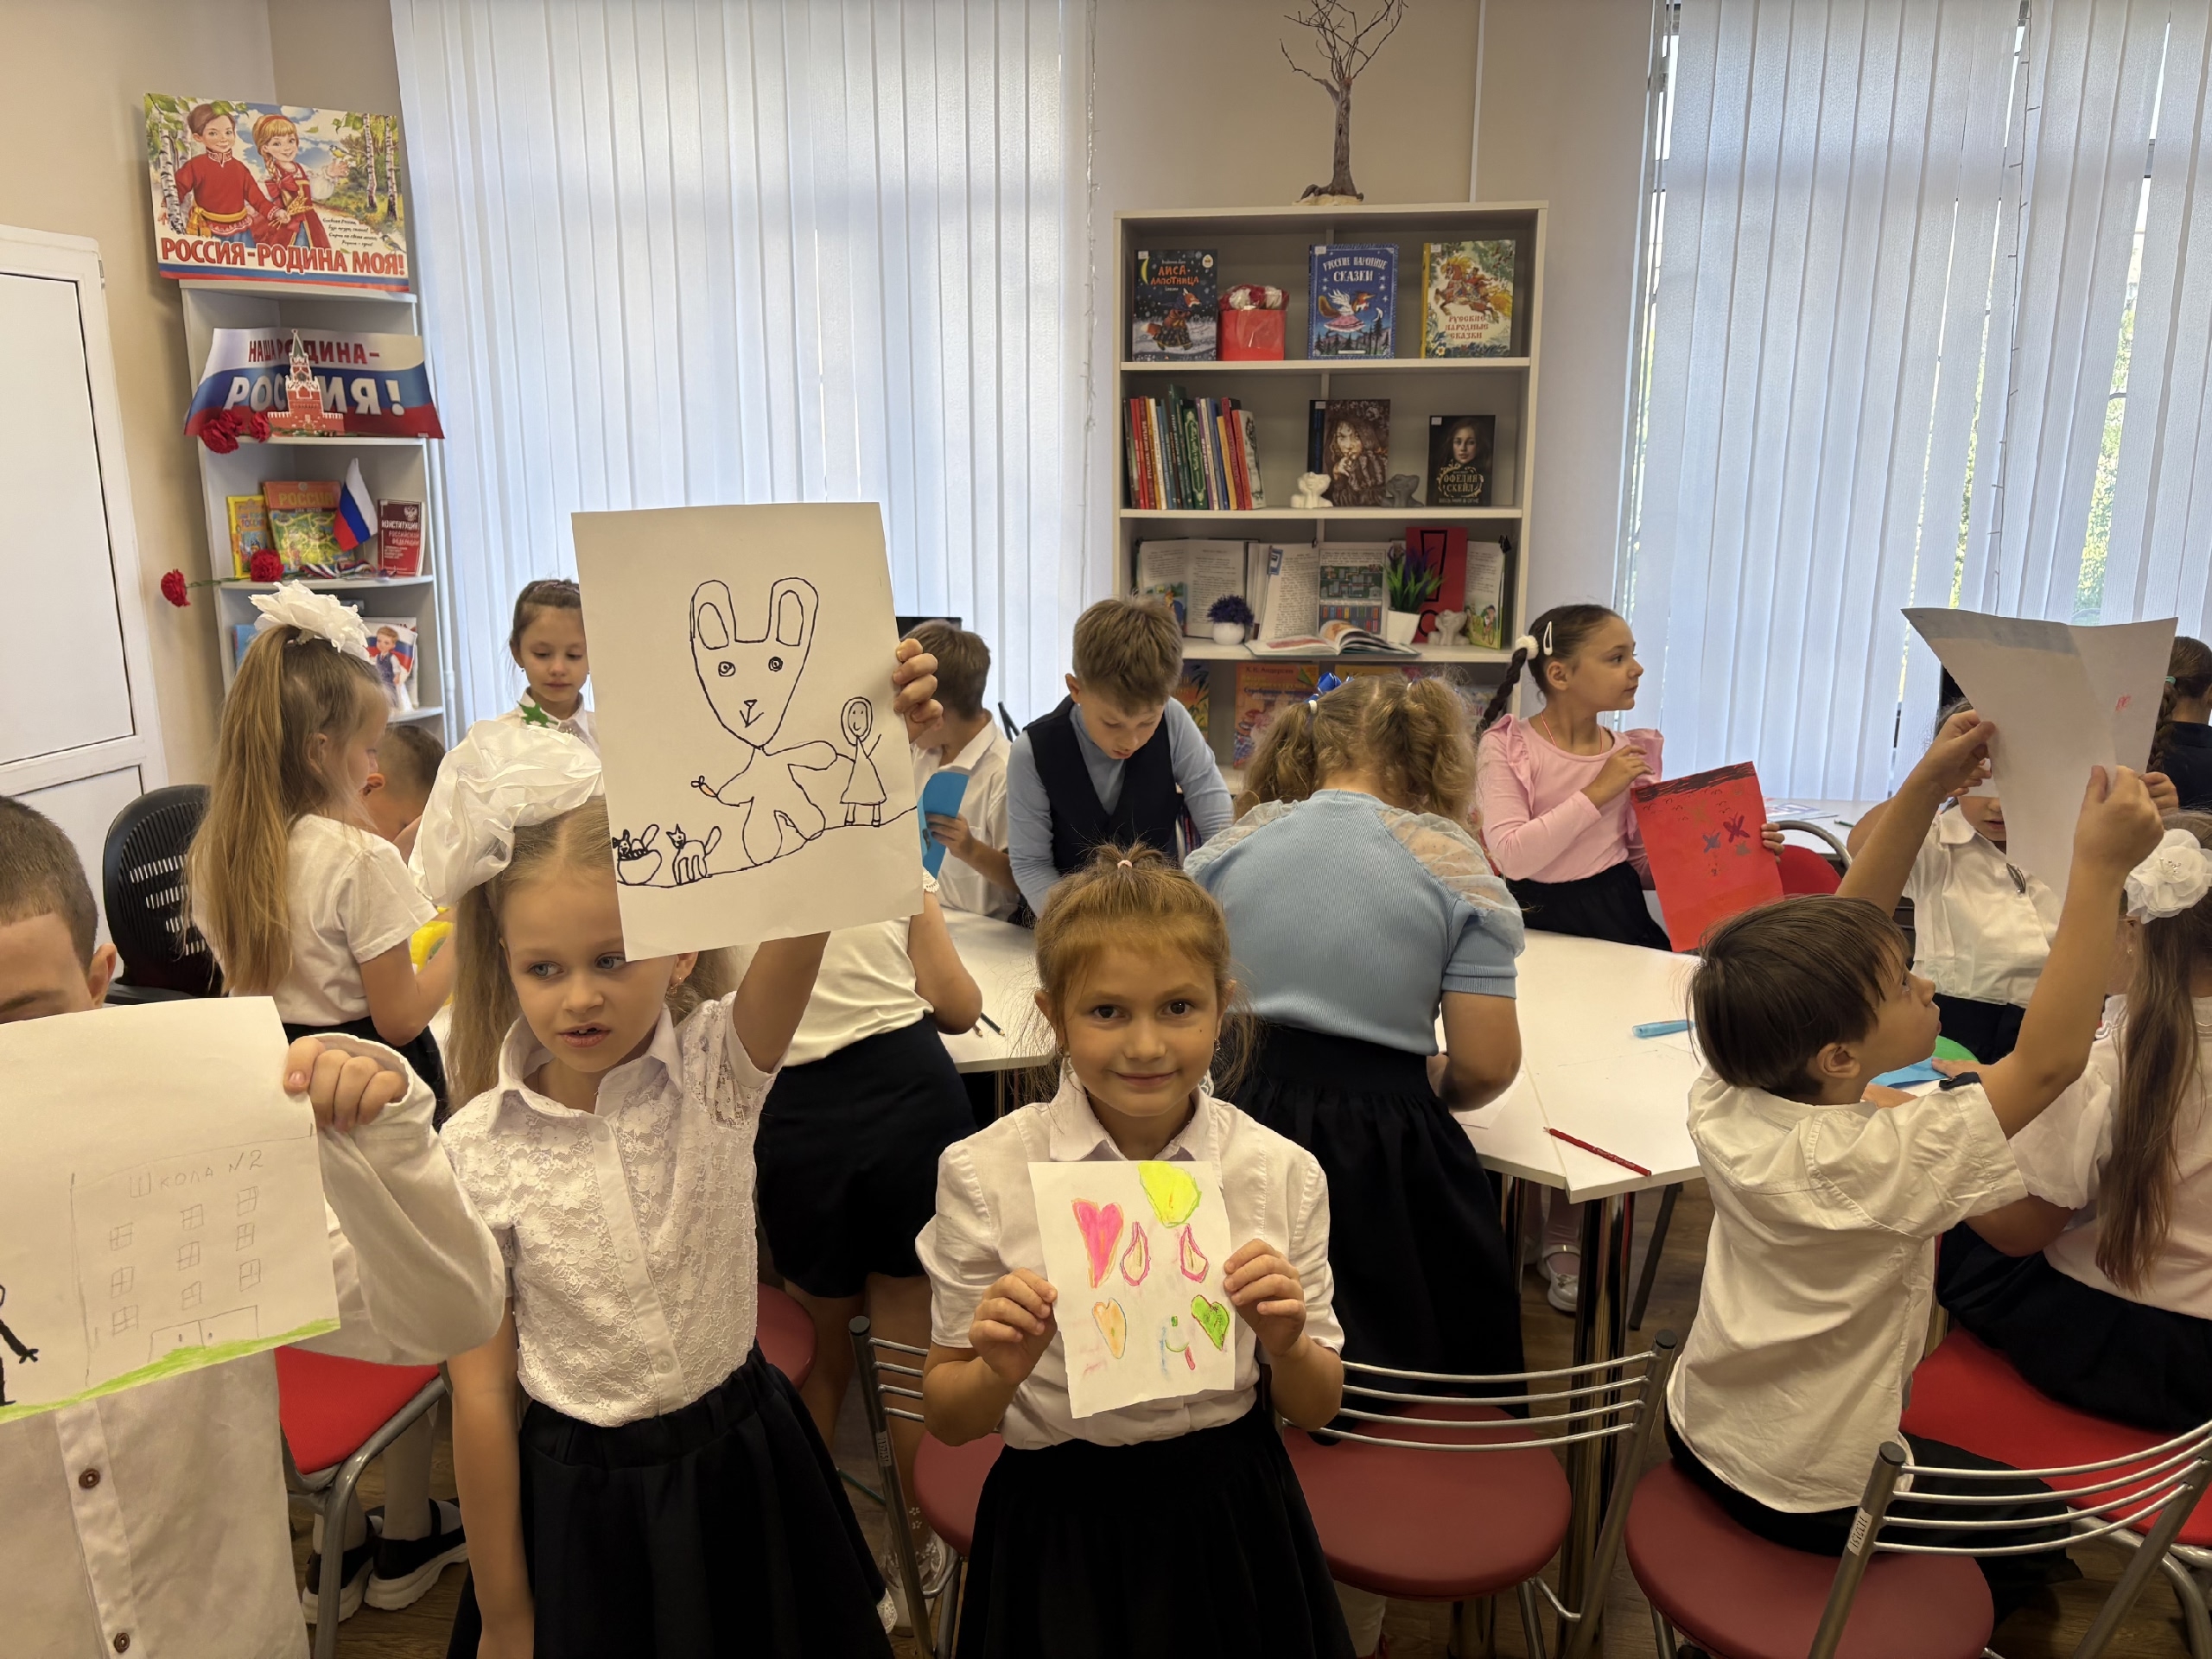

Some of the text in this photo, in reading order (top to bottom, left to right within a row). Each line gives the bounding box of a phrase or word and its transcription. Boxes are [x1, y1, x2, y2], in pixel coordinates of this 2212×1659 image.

[352, 251, 404, 276] МОЯ!
[1150, 276, 1199, 286] ЛАПОТНИЦА
[1333, 270, 1374, 282] СКАЗКИ
[248, 340, 276, 363] НАША
[223, 373, 404, 416] РОСИЯ!
[1444, 474, 1478, 483] ОФЕЛИЯ
[1446, 483, 1474, 493] СКЕЙЛ
[278, 492, 334, 506] РОССИЯ
